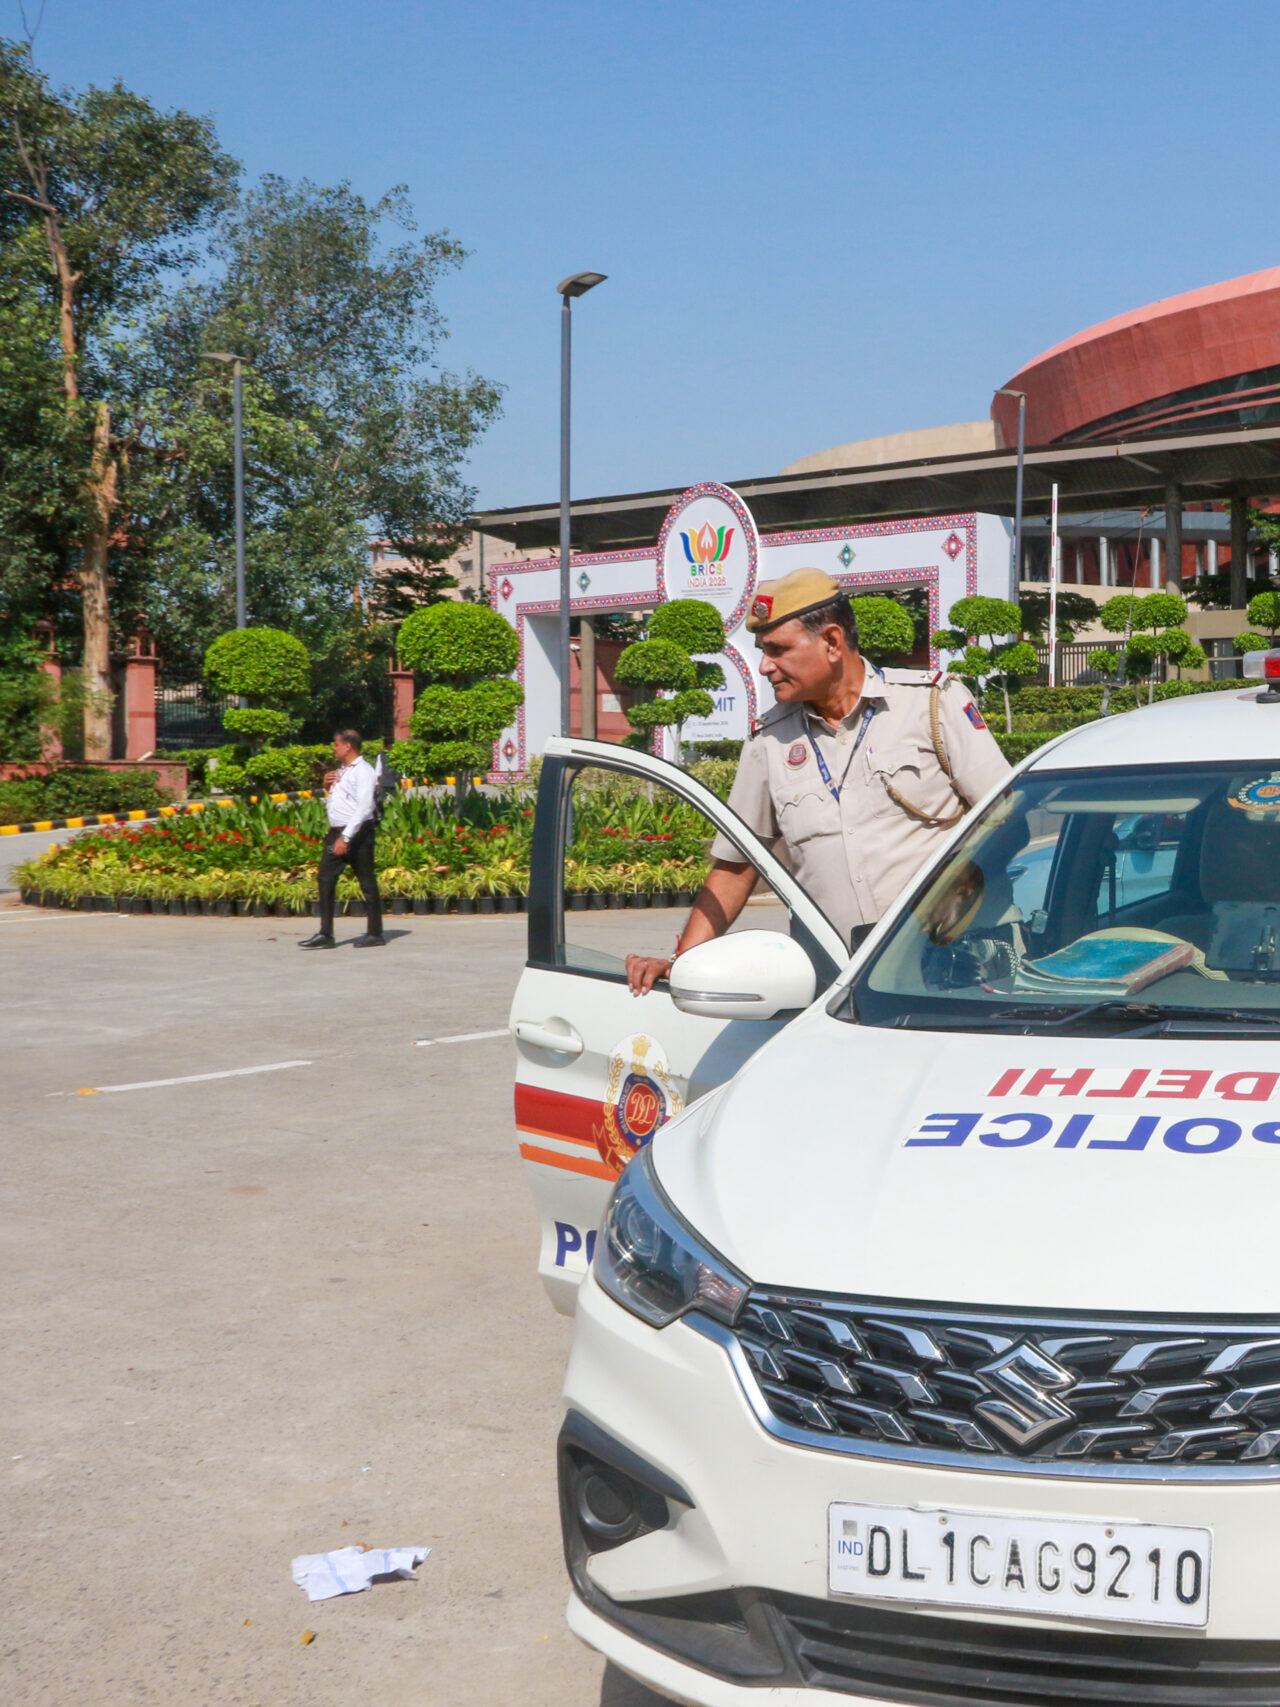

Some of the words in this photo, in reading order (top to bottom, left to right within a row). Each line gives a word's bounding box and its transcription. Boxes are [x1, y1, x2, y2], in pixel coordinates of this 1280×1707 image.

[691, 563, 723, 577] BRICS
[687, 578, 707, 588] INDIA
[837, 1539, 864, 1556] IND
[867, 1524, 1203, 1605] DL1CAG9210
